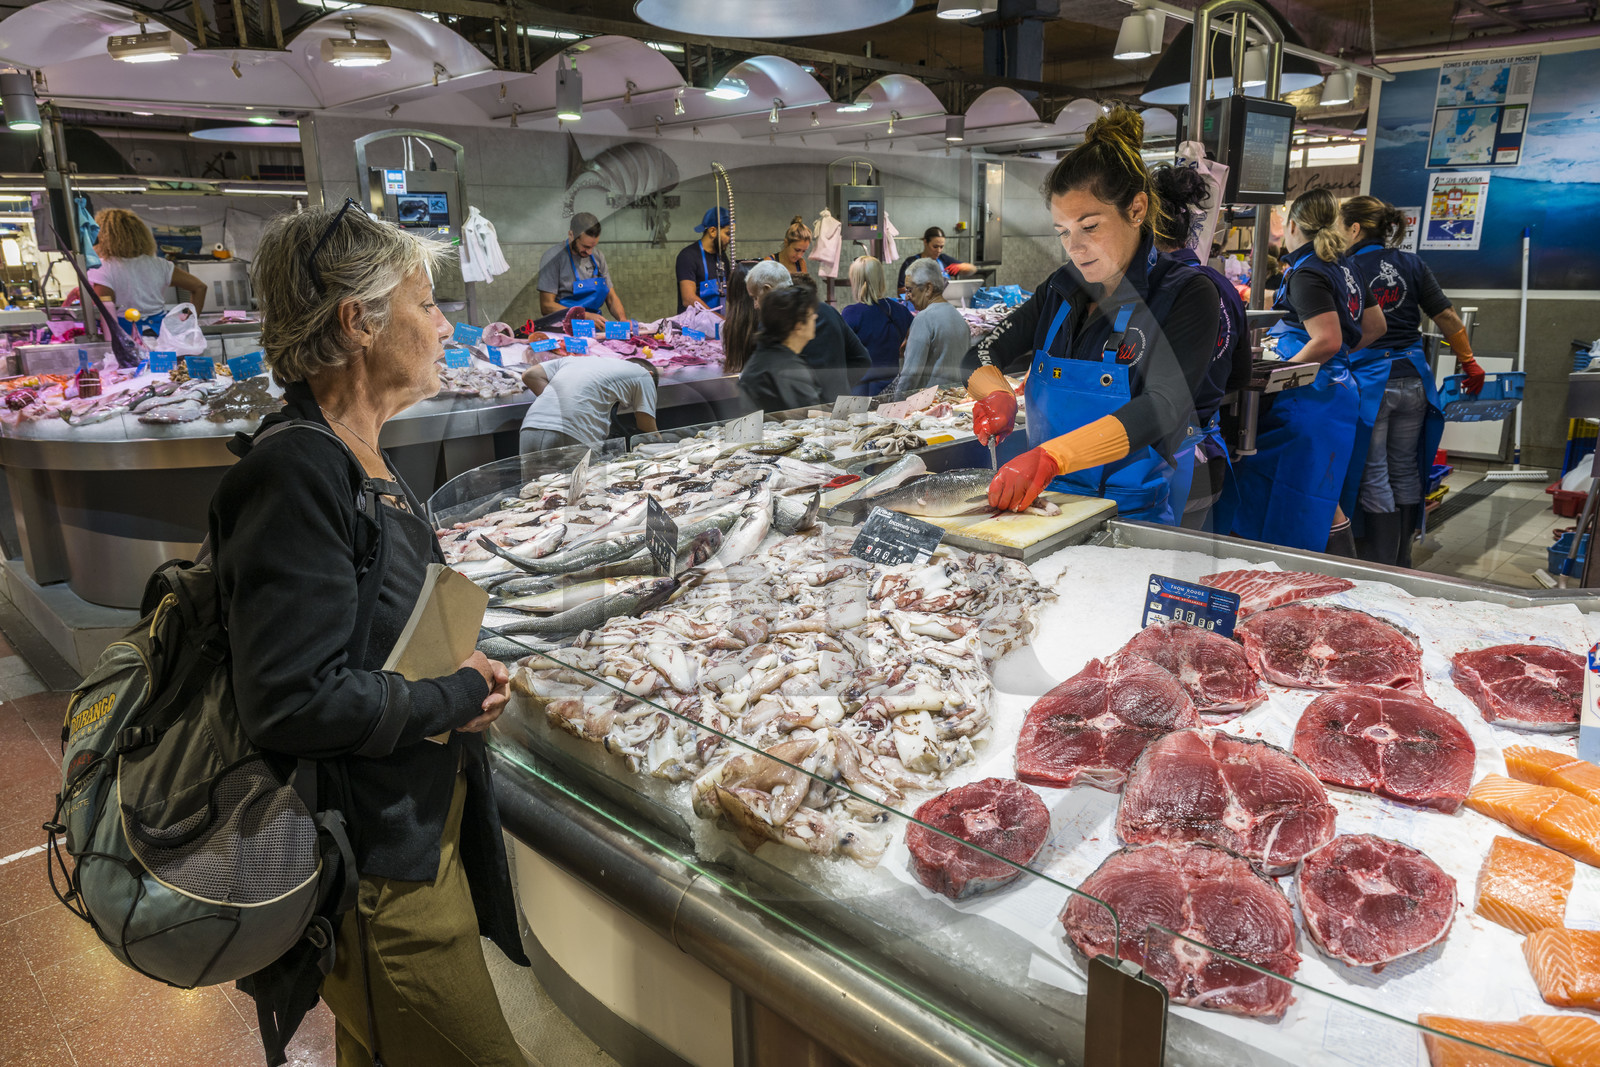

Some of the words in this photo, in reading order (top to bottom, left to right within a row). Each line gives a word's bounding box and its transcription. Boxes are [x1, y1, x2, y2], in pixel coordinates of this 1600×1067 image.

[1443, 61, 1461, 69] ZONES
[1462, 60, 1470, 68] DE
[1489, 57, 1506, 66] DANS
[1507, 56, 1514, 64] LE
[1515, 54, 1538, 63] MONDE
[70, 692, 116, 734] DURANGO
